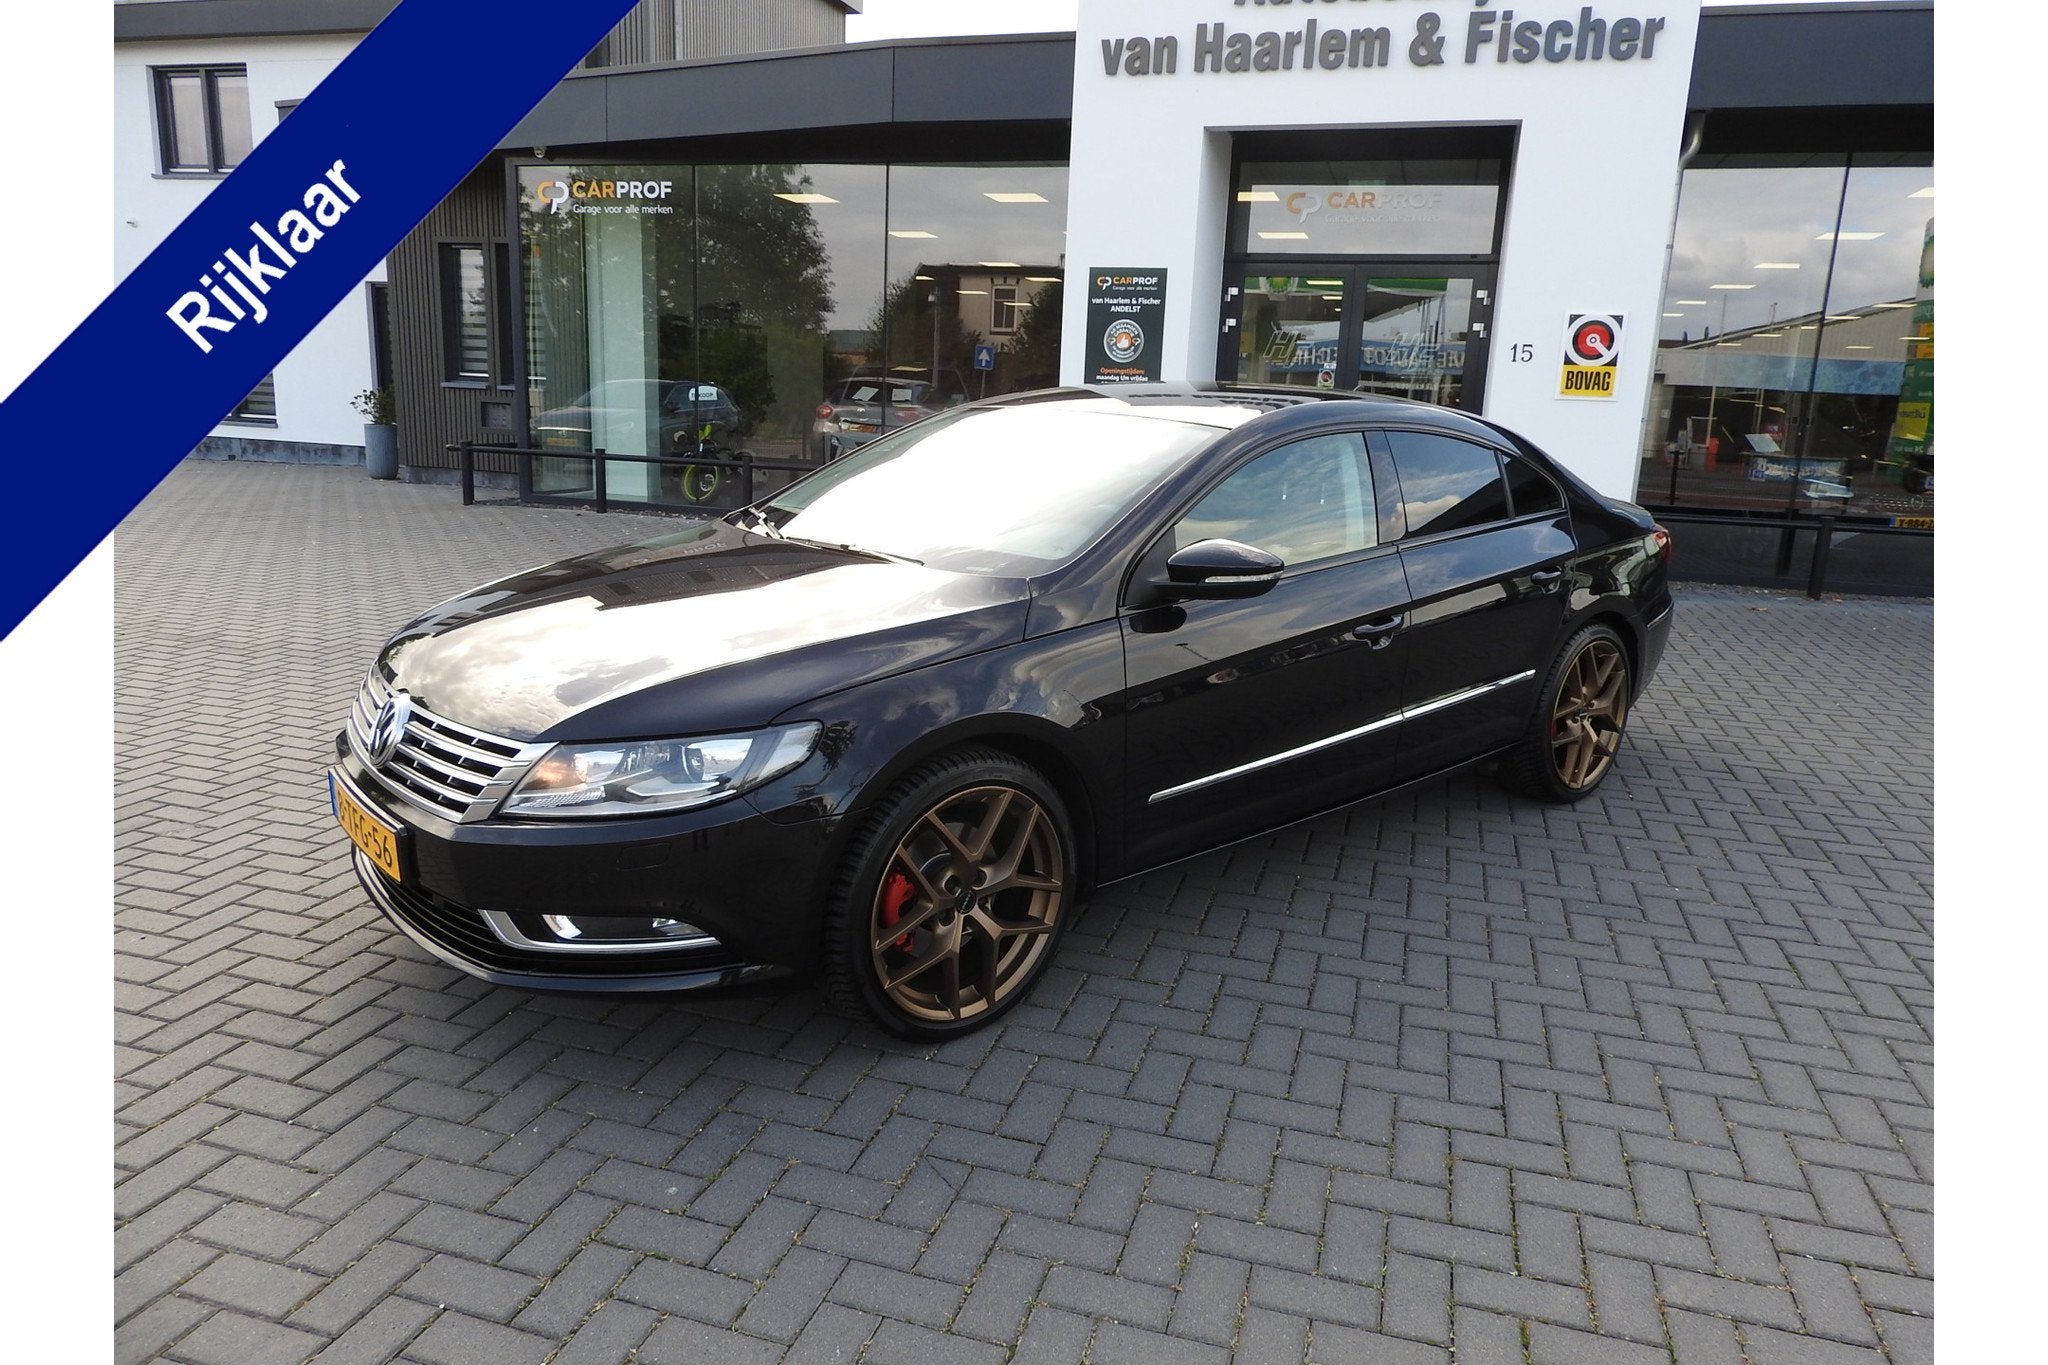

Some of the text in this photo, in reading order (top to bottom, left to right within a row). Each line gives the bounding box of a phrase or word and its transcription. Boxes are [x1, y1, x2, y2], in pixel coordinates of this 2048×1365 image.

[1101, 7, 1665, 76] van Haarlem & Fischer
[573, 180, 672, 198] CARPROF
[573, 204, 673, 214] Garage voor alle merken
[1113, 277, 1158, 285] CARPROF
[1138, 297, 1161, 305] Fischer
[1110, 305, 1141, 313] ANDELST
[1510, 343, 1533, 362] 15
[1565, 371, 1611, 391] BOVAG
